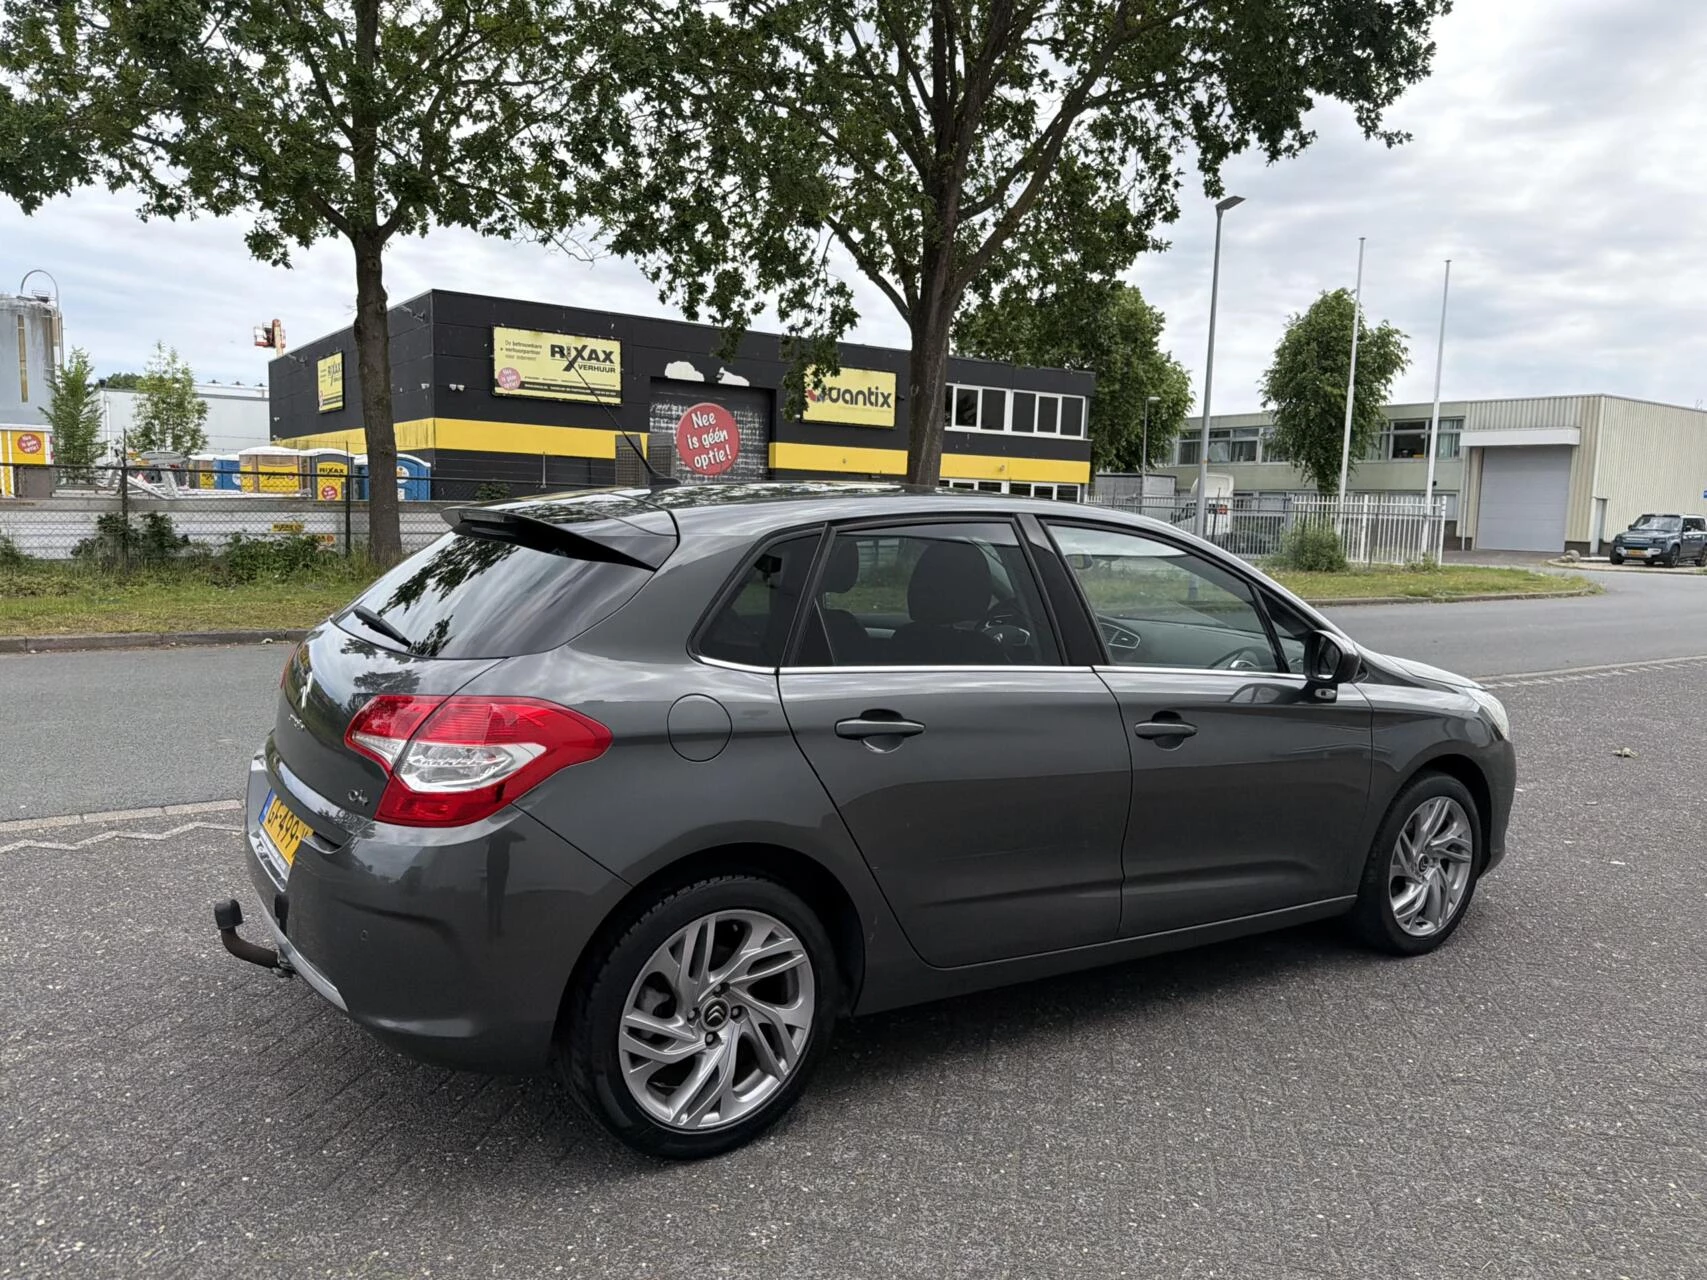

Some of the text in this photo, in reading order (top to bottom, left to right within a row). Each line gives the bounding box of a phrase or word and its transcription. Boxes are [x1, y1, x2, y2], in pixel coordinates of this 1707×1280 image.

[578, 364, 616, 374] VERHUUR
[691, 410, 717, 429] Nee
[686, 426, 729, 450] is géén
[347, 789, 369, 807] C4
